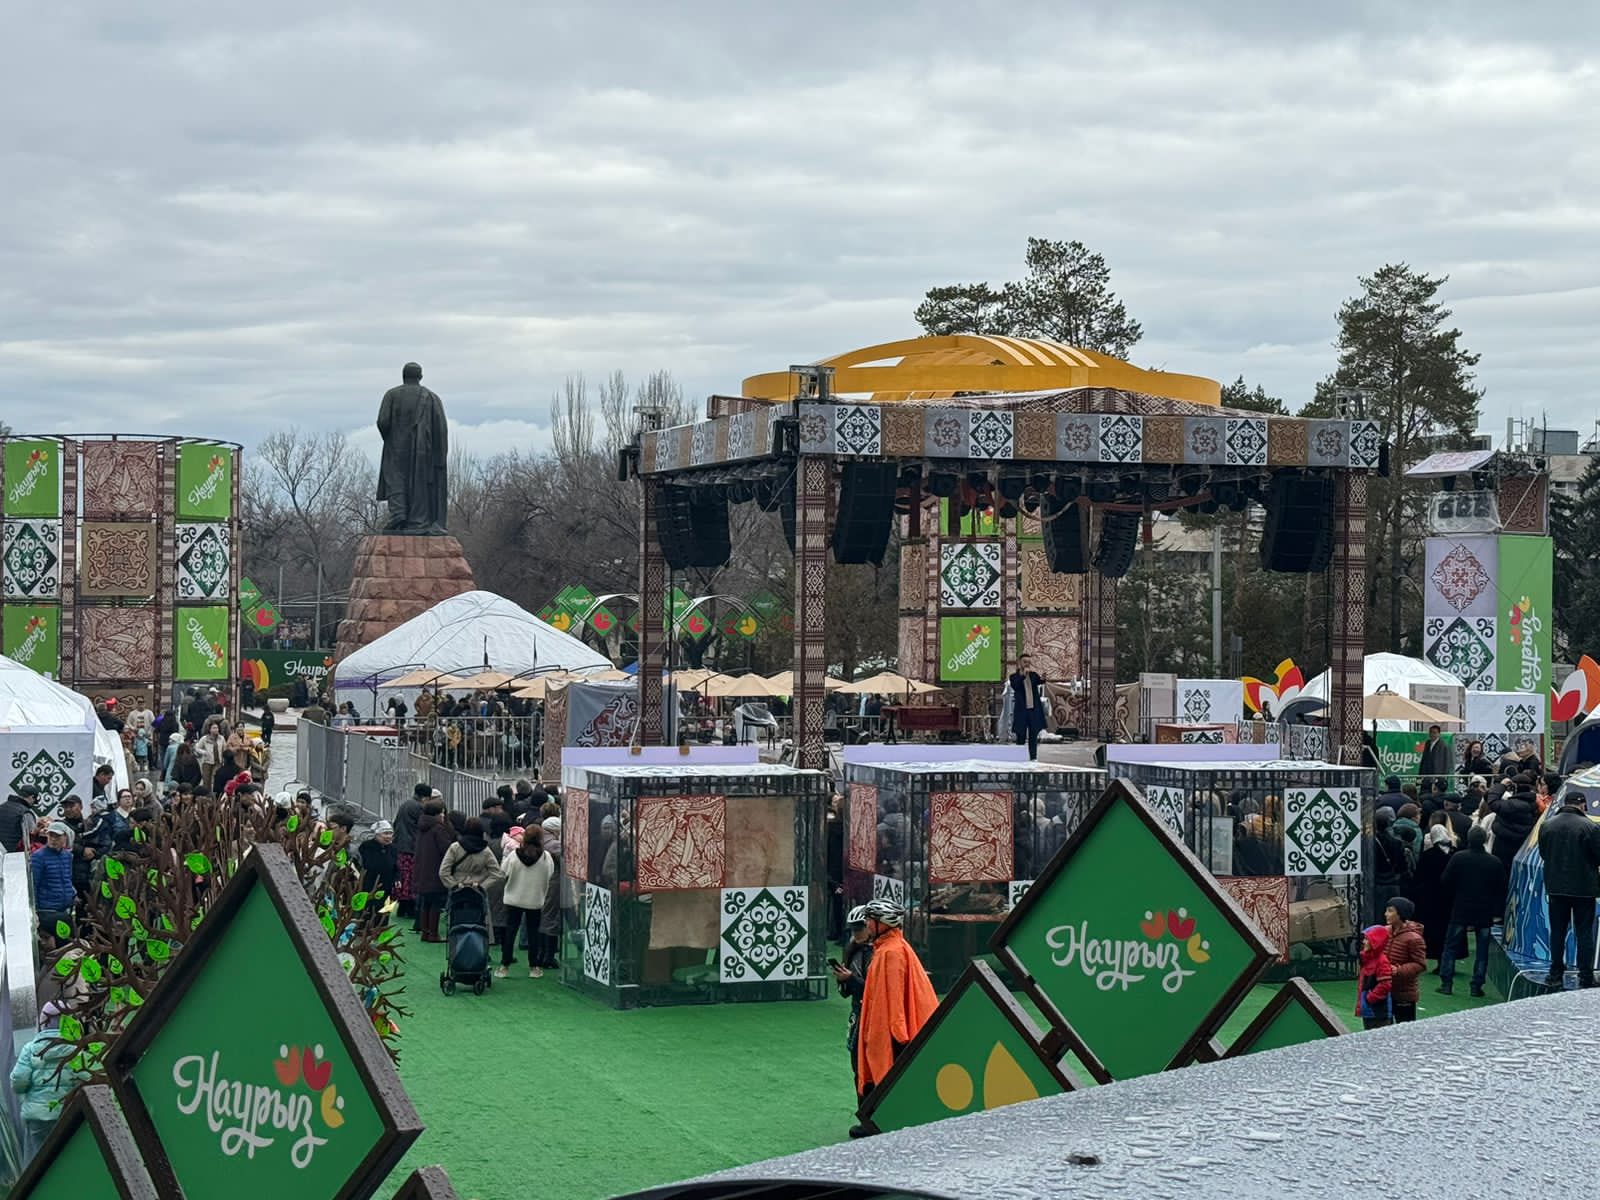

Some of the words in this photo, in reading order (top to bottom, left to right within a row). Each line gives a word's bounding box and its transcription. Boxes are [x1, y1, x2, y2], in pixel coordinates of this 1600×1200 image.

[9, 460, 48, 503] Наурыз
[188, 465, 225, 506] Наурыз
[186, 617, 218, 668] Наурыз
[947, 634, 990, 672] Наурыз
[1045, 920, 1197, 993] Наурыз
[173, 1050, 329, 1169] Наурыз
